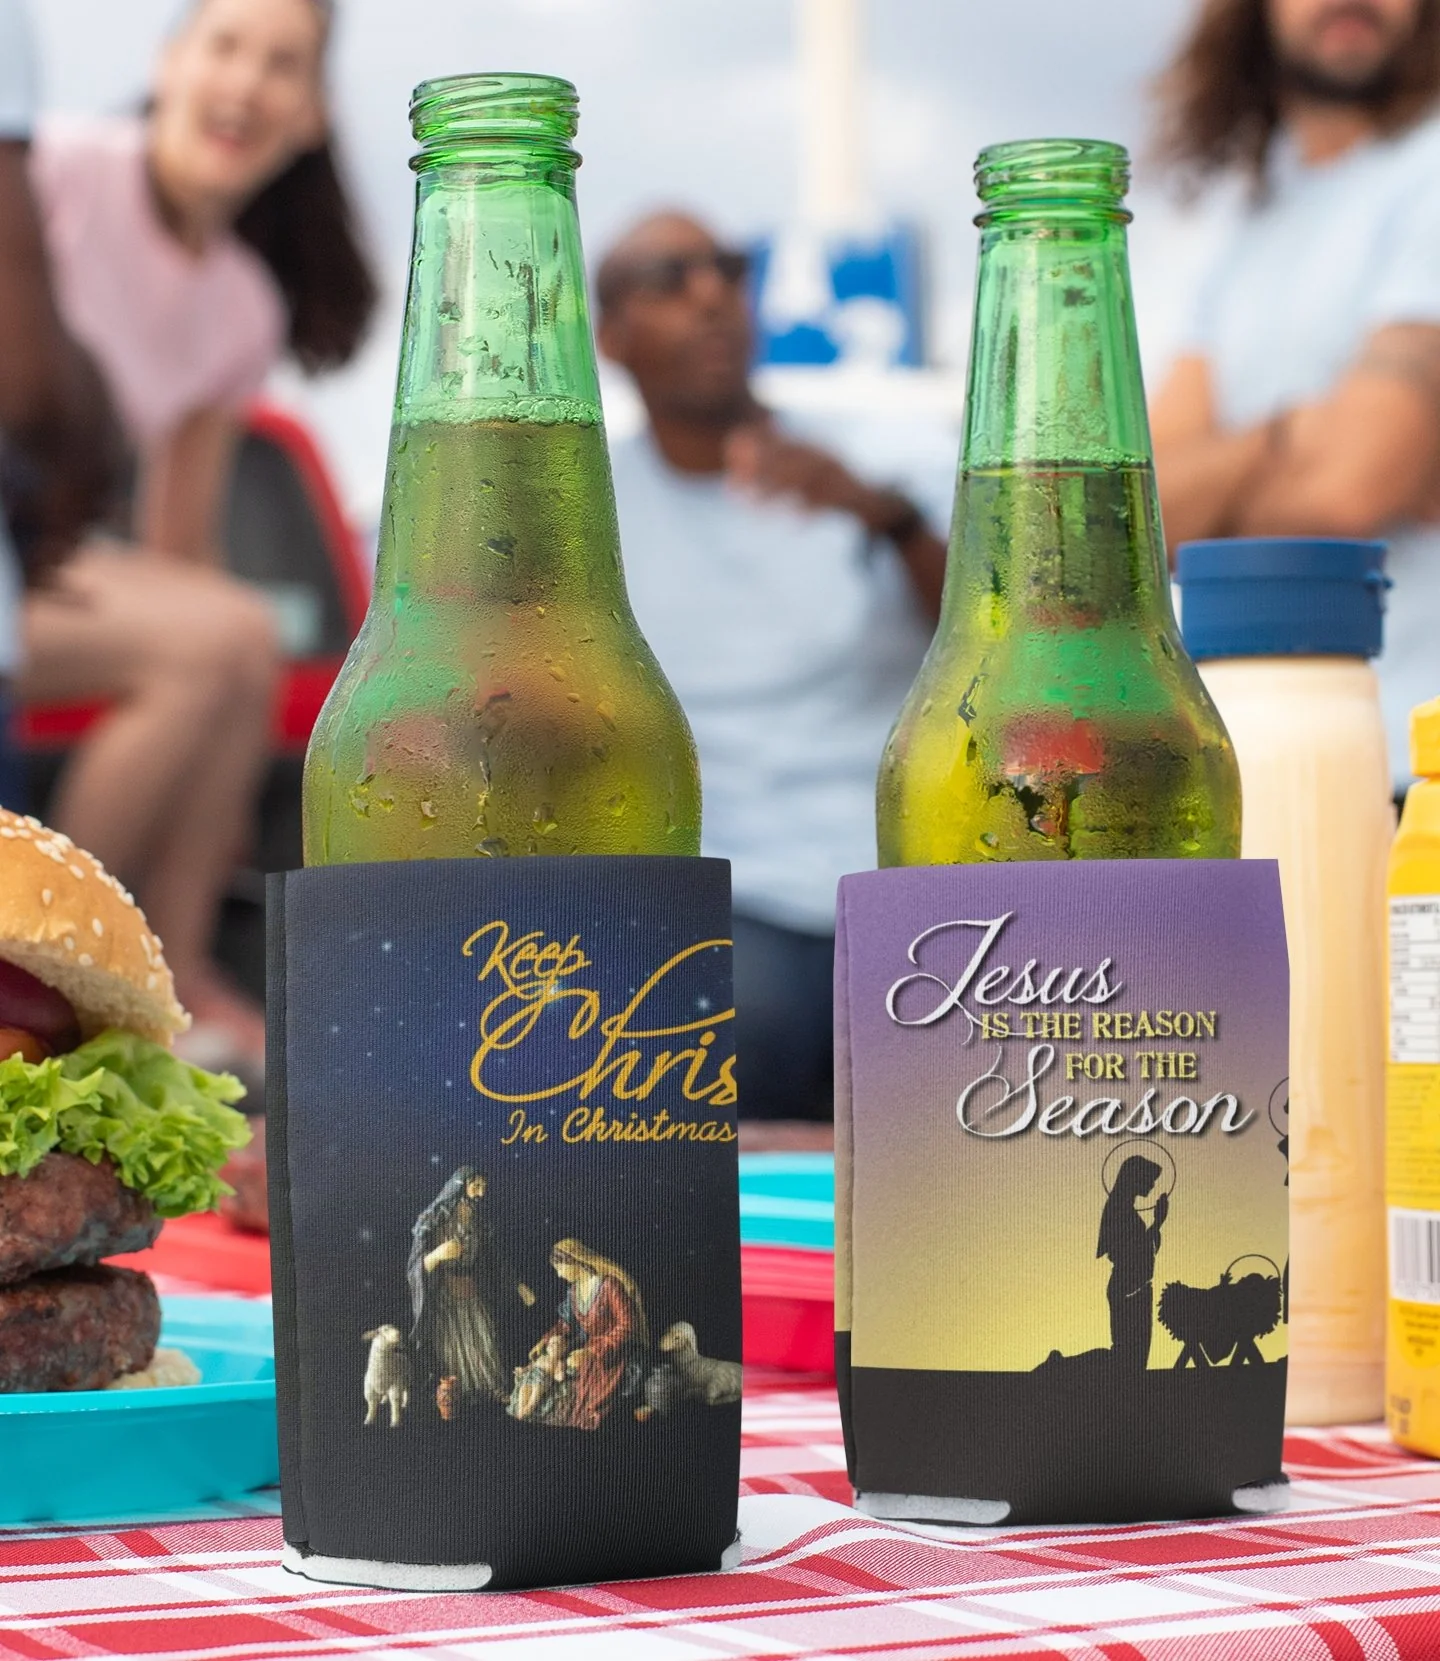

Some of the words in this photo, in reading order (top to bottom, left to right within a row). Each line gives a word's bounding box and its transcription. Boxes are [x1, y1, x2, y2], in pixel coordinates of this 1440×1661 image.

[462, 919, 592, 1000] Keep
[885, 911, 1123, 1046] Jesus
[980, 1011, 1010, 1040] IS
[1020, 1011, 1082, 1040] THE
[1091, 1009, 1217, 1040] REASON
[955, 1043, 1255, 1138] Season
[1065, 1051, 1126, 1080] FOR
[1136, 1051, 1198, 1080] THE
[501, 1109, 548, 1144] In
[562, 1106, 738, 1144] Christmas
